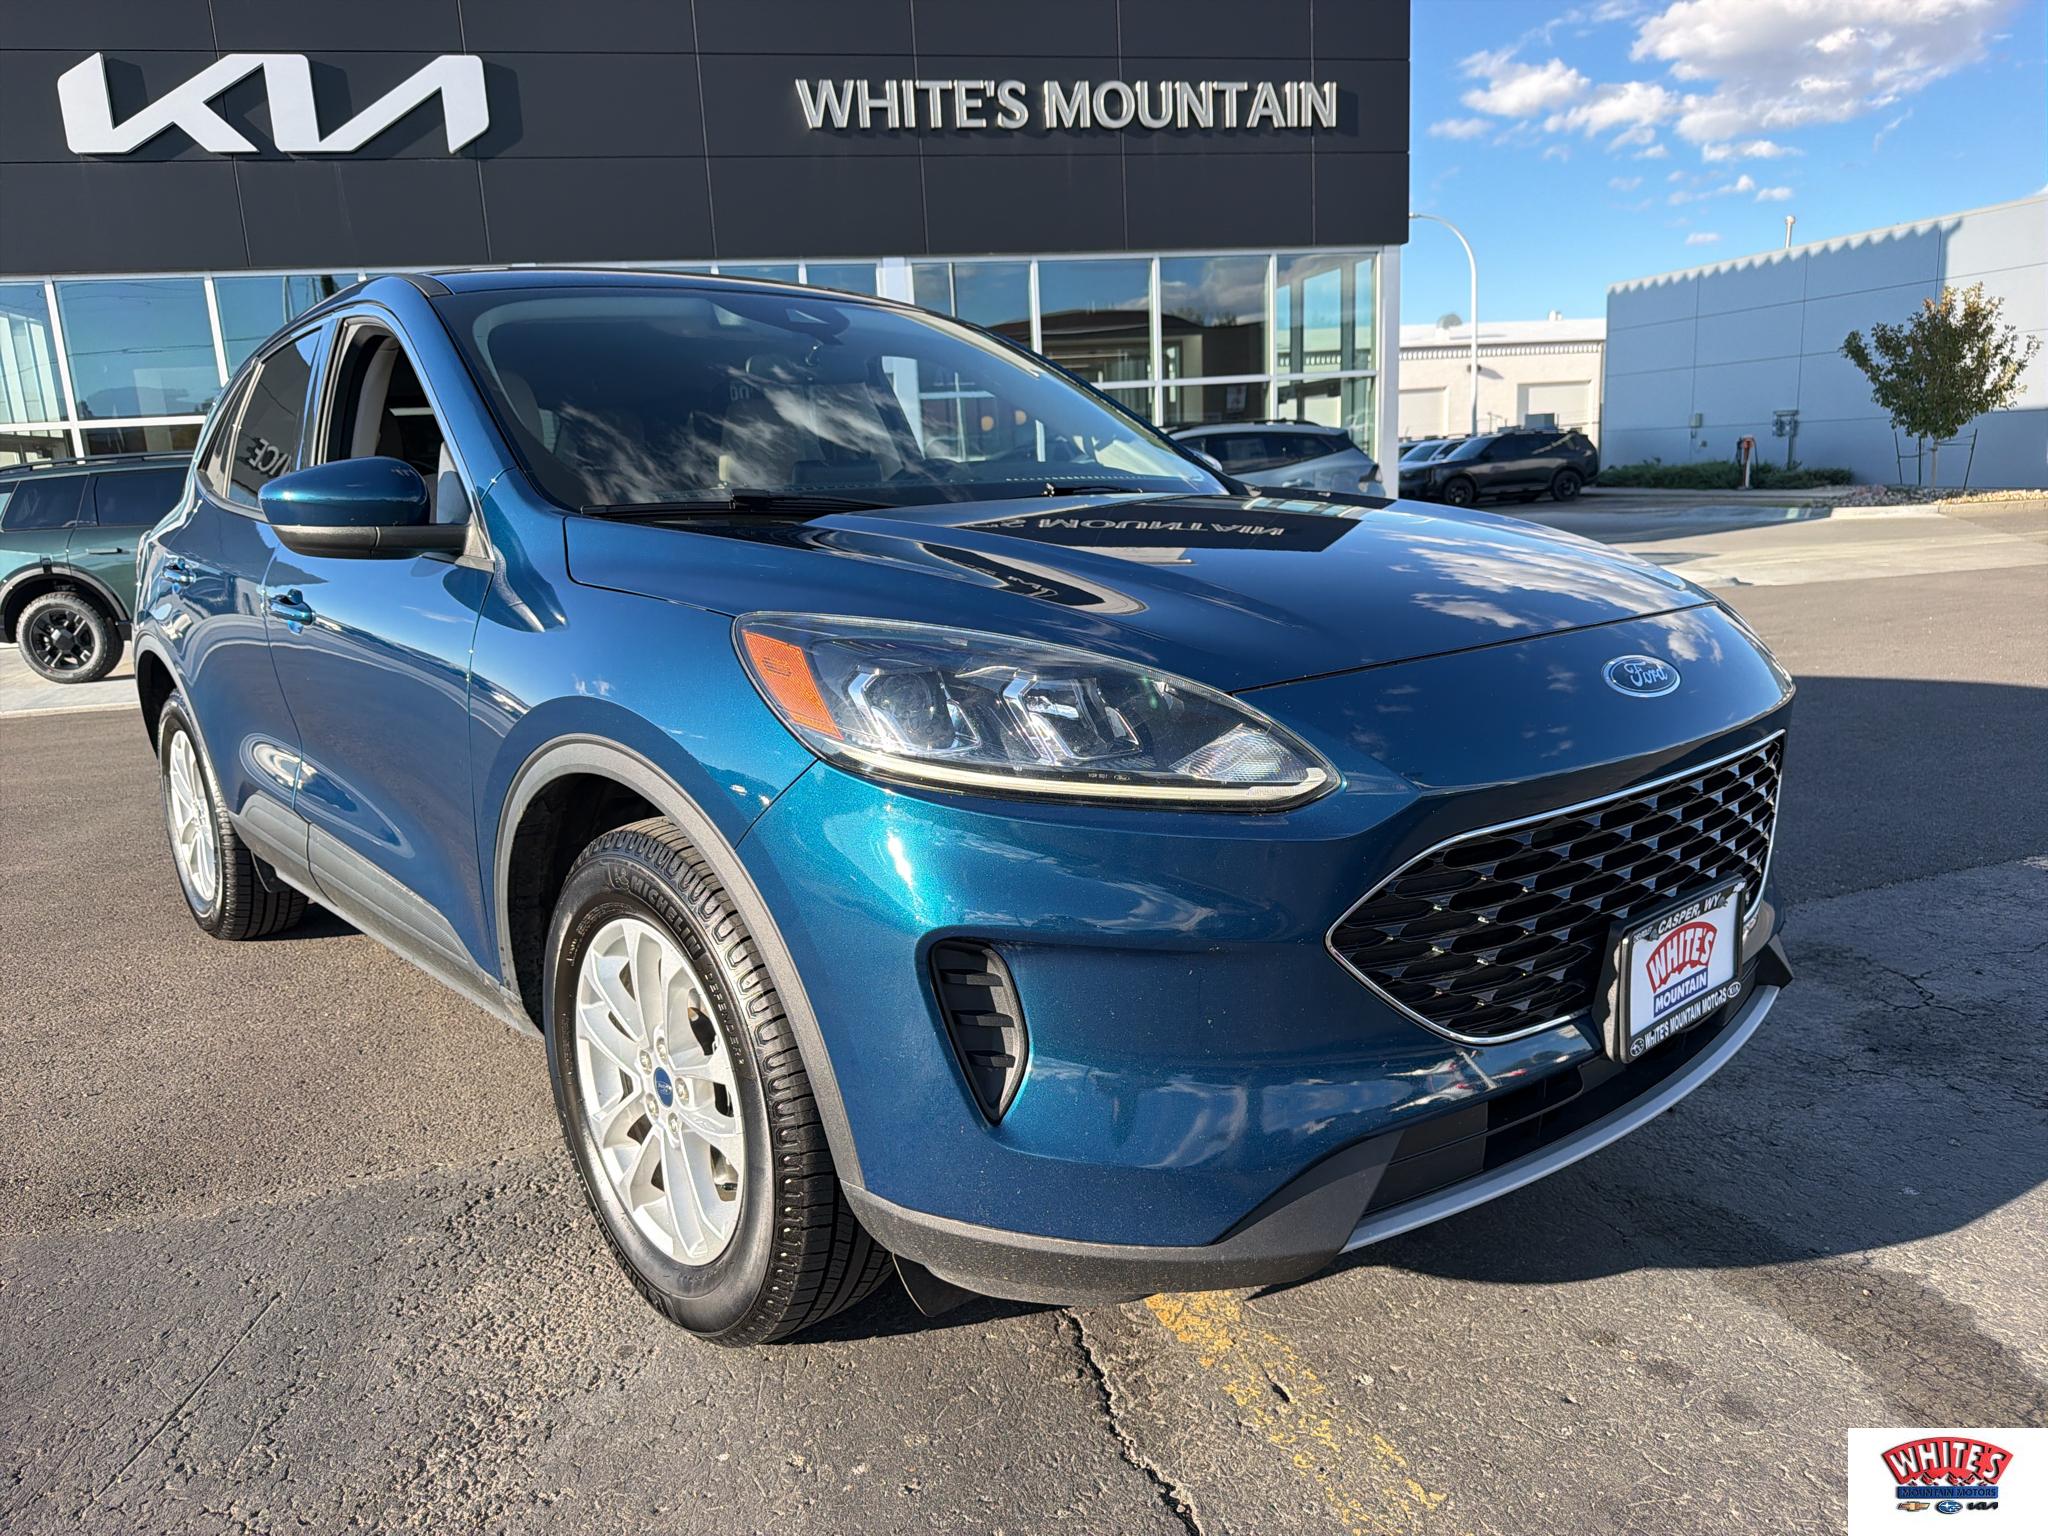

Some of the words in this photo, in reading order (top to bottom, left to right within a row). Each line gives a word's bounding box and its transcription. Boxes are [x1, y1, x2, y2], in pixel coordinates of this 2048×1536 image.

[795, 78, 1029, 130] WHITE'S
[1043, 79, 1337, 130] MOUNTAIN
[1623, 661, 1668, 687] Ford
[630, 875, 701, 957] MICHELIN
[1658, 903, 1701, 934] CASPER,
[1704, 893, 1721, 911] WY
[1649, 925, 1715, 989] WHITE'S
[1655, 972, 1707, 1013] MOUNTAIN
[1669, 1004, 1702, 1034] MOUNTAIN
[1701, 987, 1727, 1014] MOTORS
